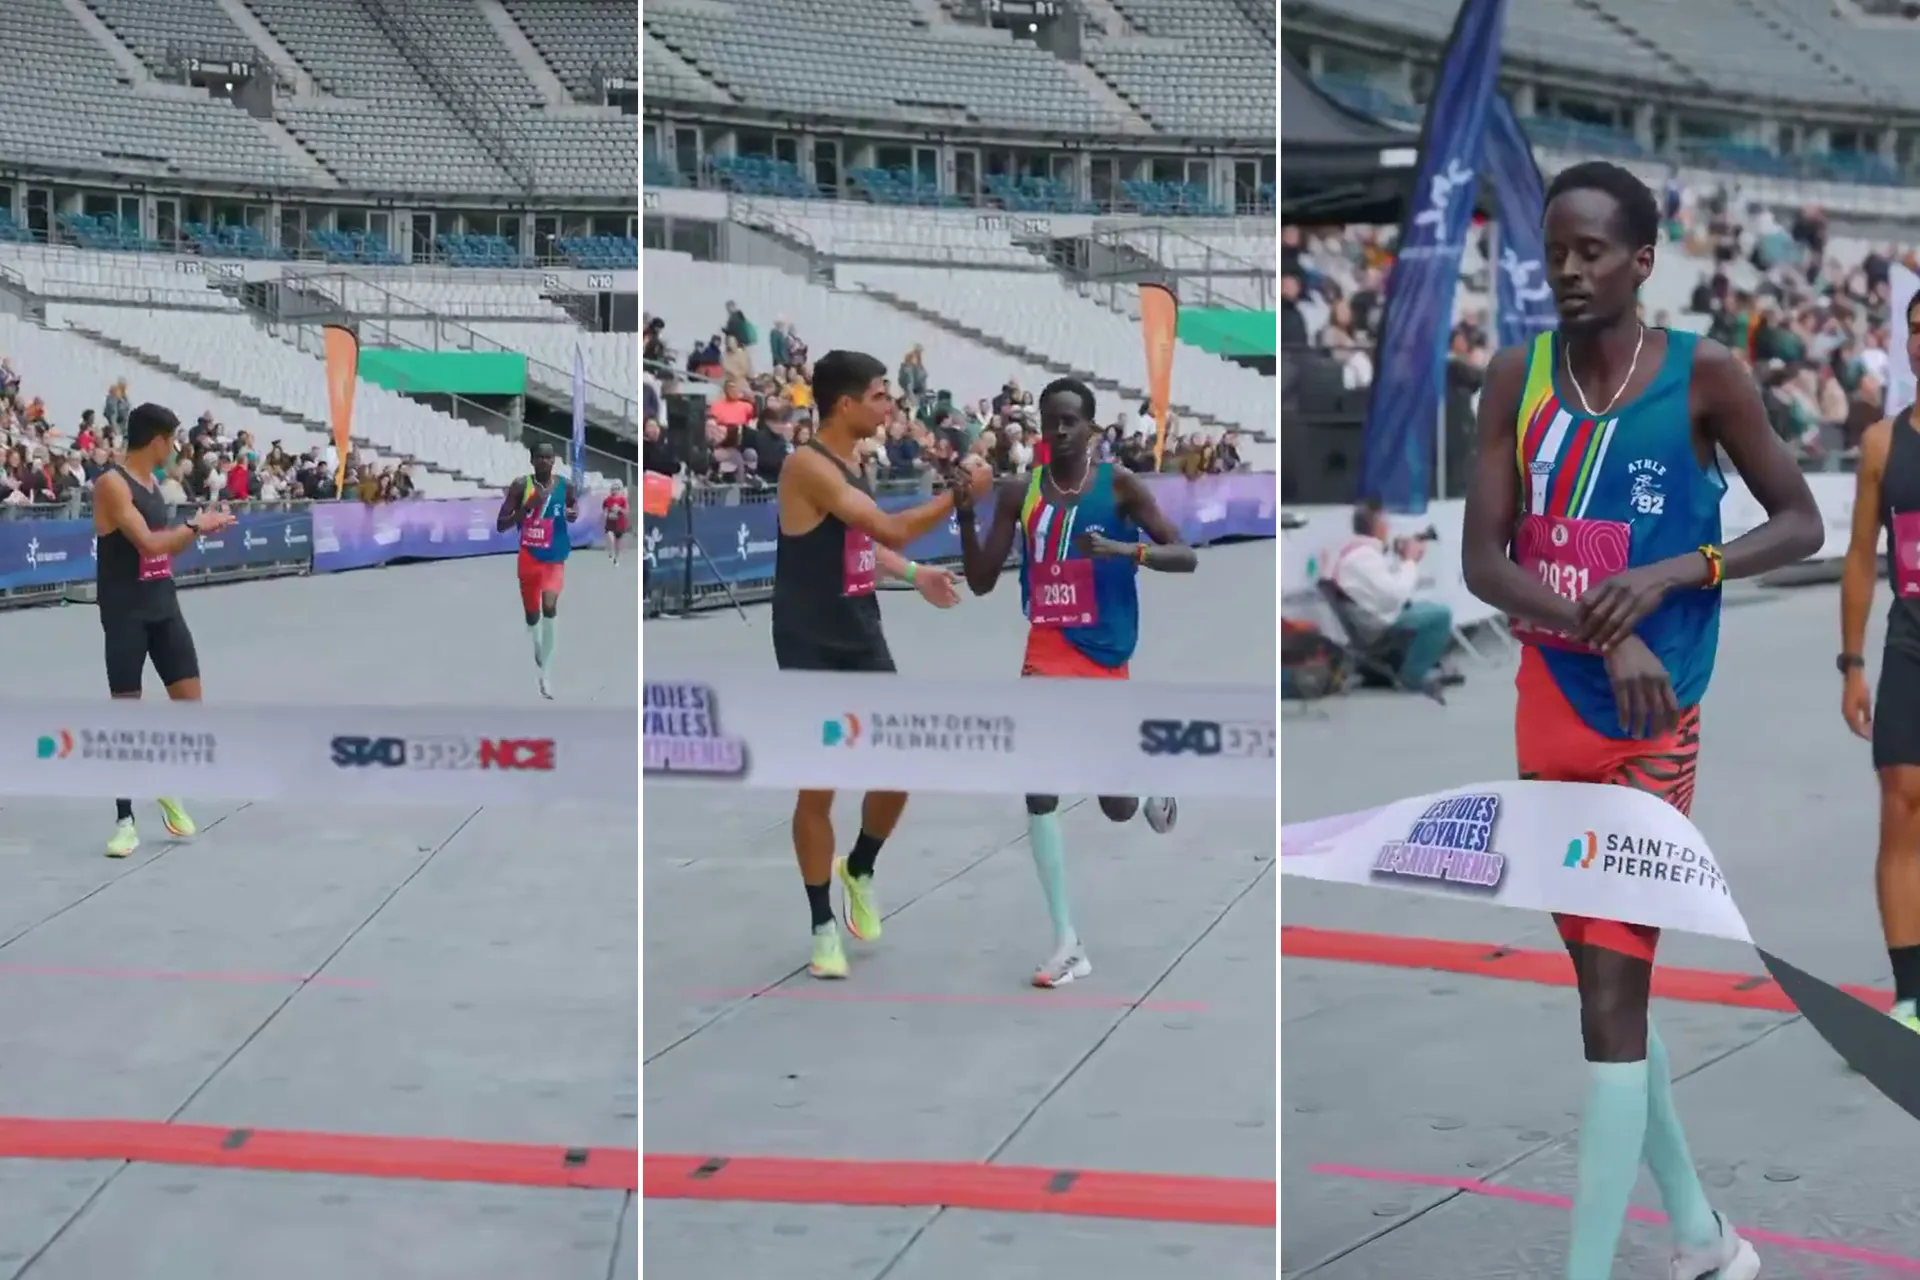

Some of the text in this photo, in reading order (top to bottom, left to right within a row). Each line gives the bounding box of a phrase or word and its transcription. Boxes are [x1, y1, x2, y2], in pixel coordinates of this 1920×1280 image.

[1628, 458, 1667, 476] ATHLE
[1637, 496, 1664, 515] 92
[1043, 583, 1077, 606] 2931
[1446, 797, 1496, 823] VOIES
[1407, 820, 1489, 852] ROYALES
